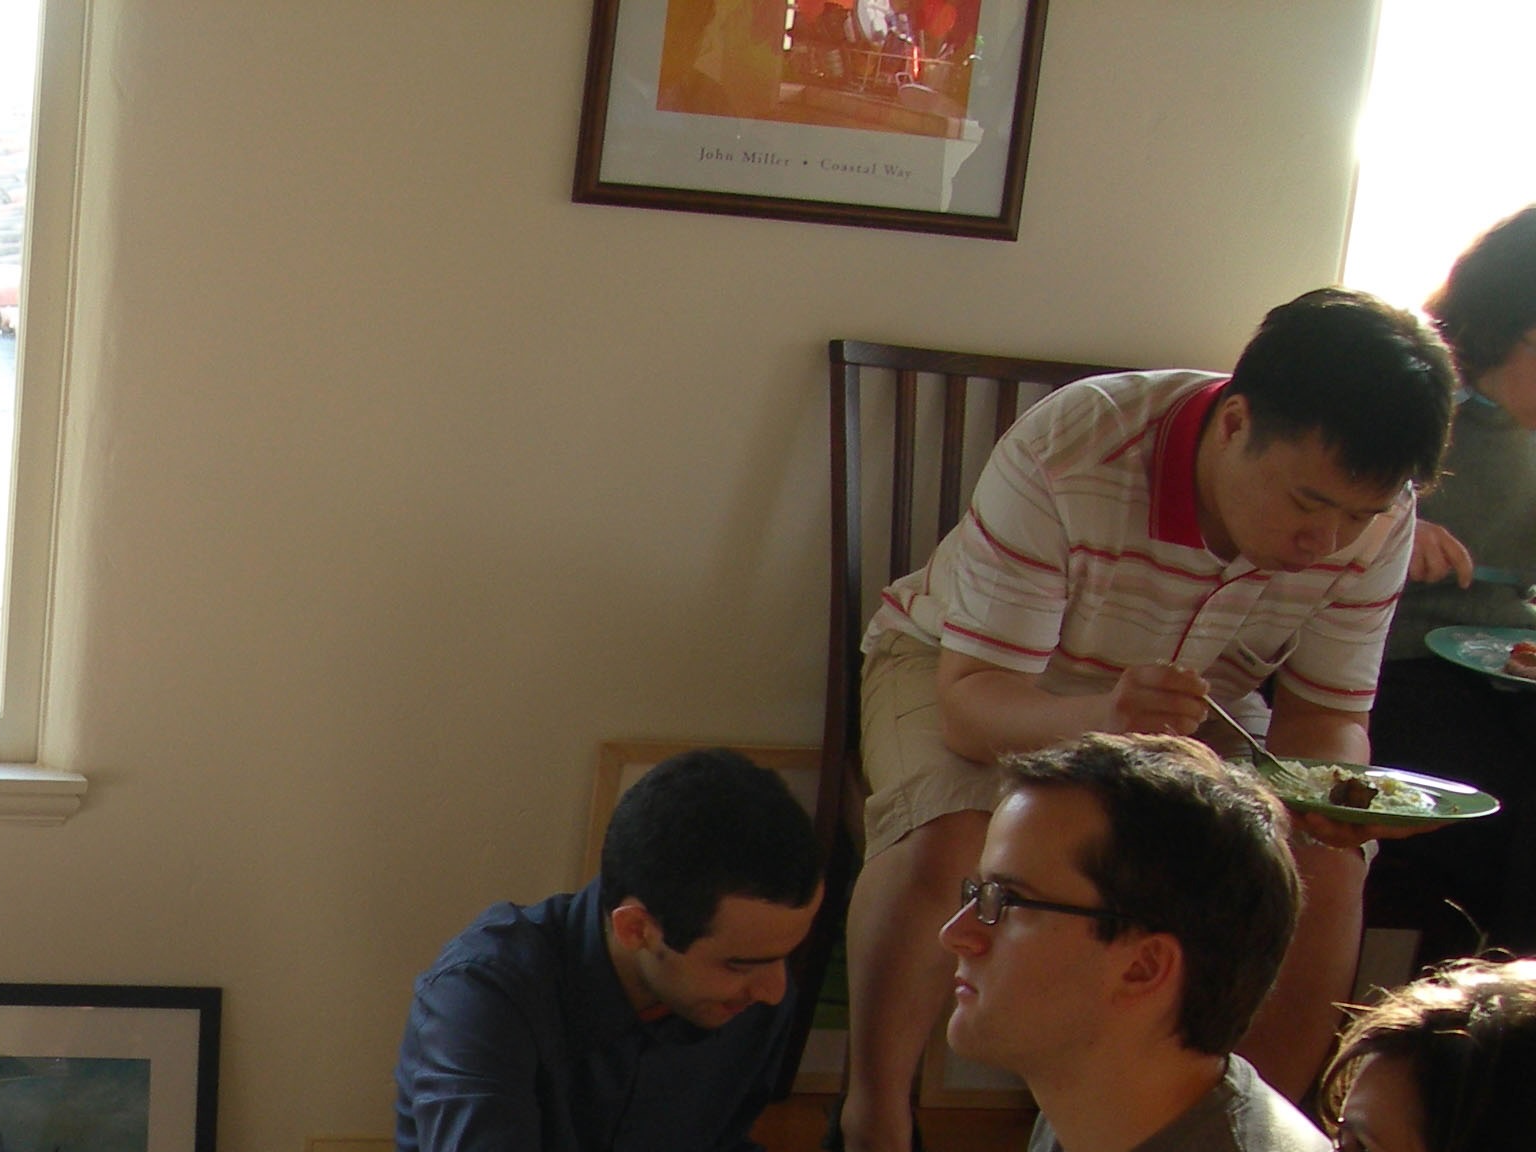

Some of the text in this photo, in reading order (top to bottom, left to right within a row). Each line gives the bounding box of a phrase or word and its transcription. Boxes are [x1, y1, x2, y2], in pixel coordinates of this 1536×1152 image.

[699, 147, 913, 180] John Miller Coastal Way
